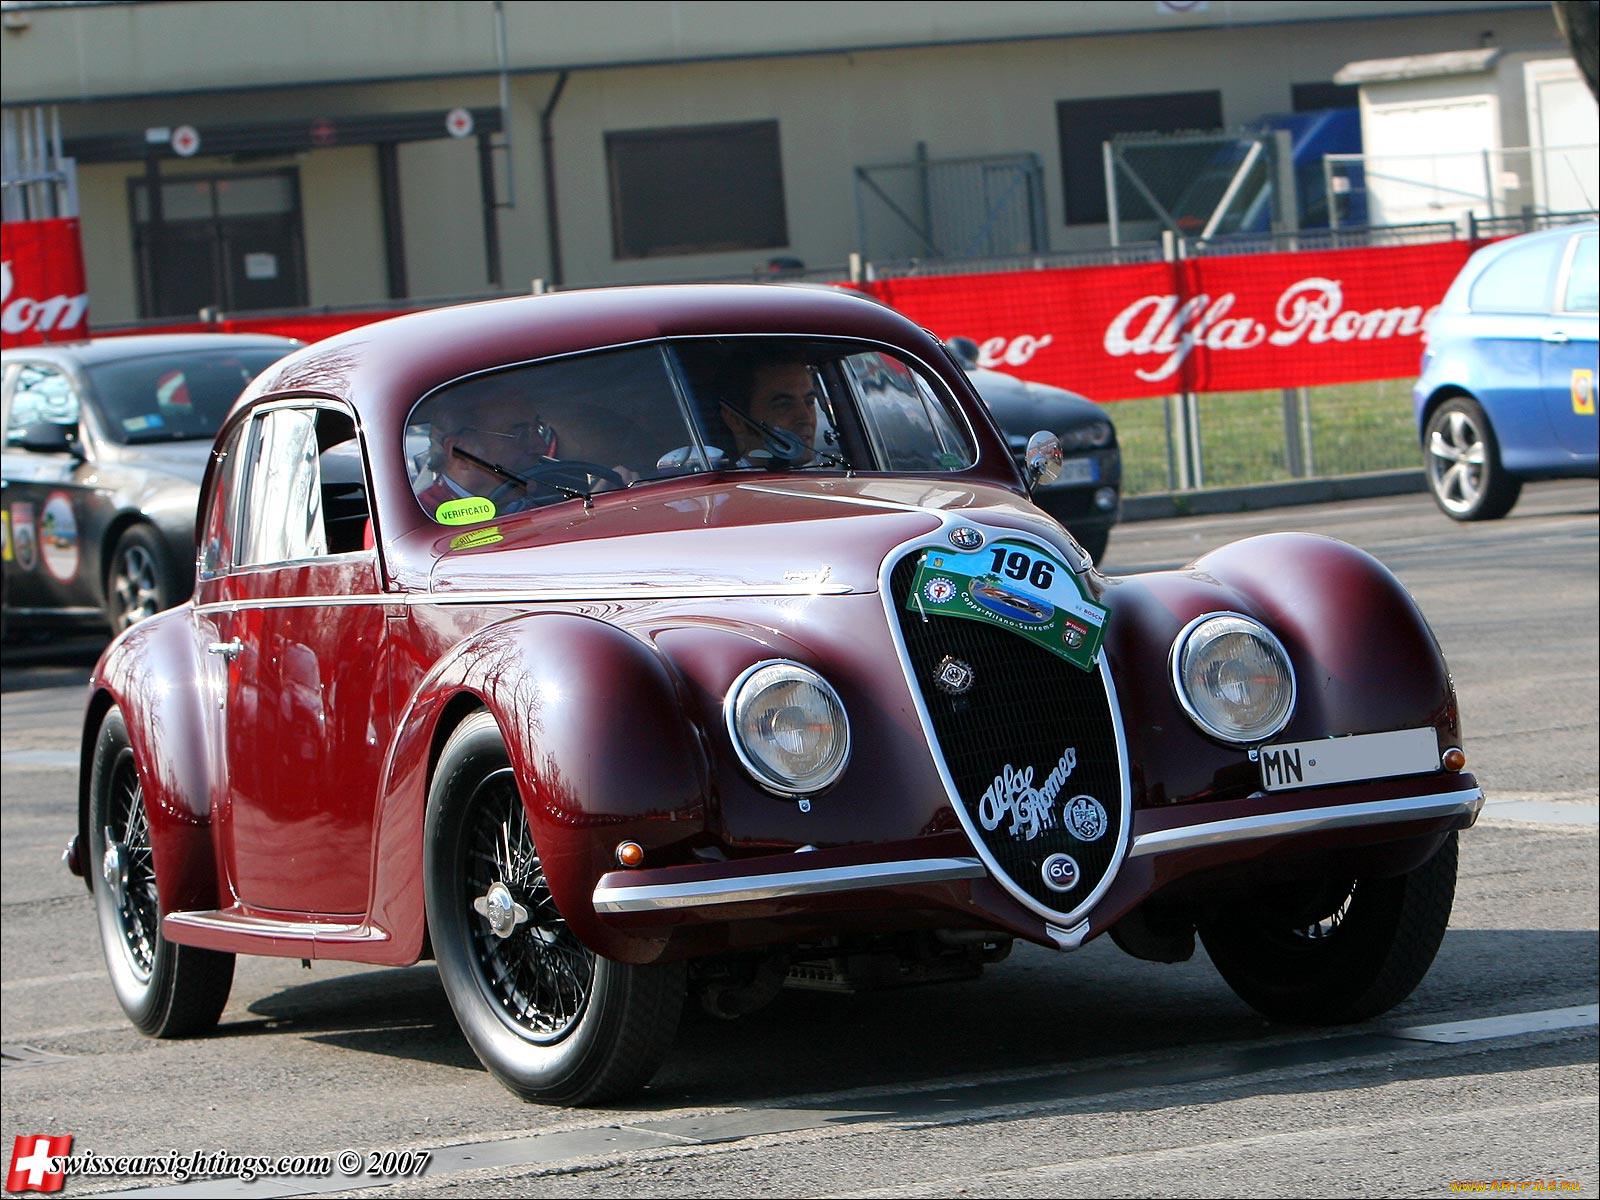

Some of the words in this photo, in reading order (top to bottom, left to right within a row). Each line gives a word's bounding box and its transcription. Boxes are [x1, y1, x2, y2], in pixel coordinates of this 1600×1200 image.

[1104, 293, 1266, 382] Alfa
[441, 505, 490, 520] VERIFICATO
[990, 548, 1055, 589] 196
[960, 591, 983, 613] Coppa
[984, 610, 1015, 627] Milano
[1018, 621, 1055, 632] Sanremo
[1083, 608, 1104, 621] BOSCH
[1263, 748, 1303, 786] MN
[1050, 862, 1074, 877] 6C
